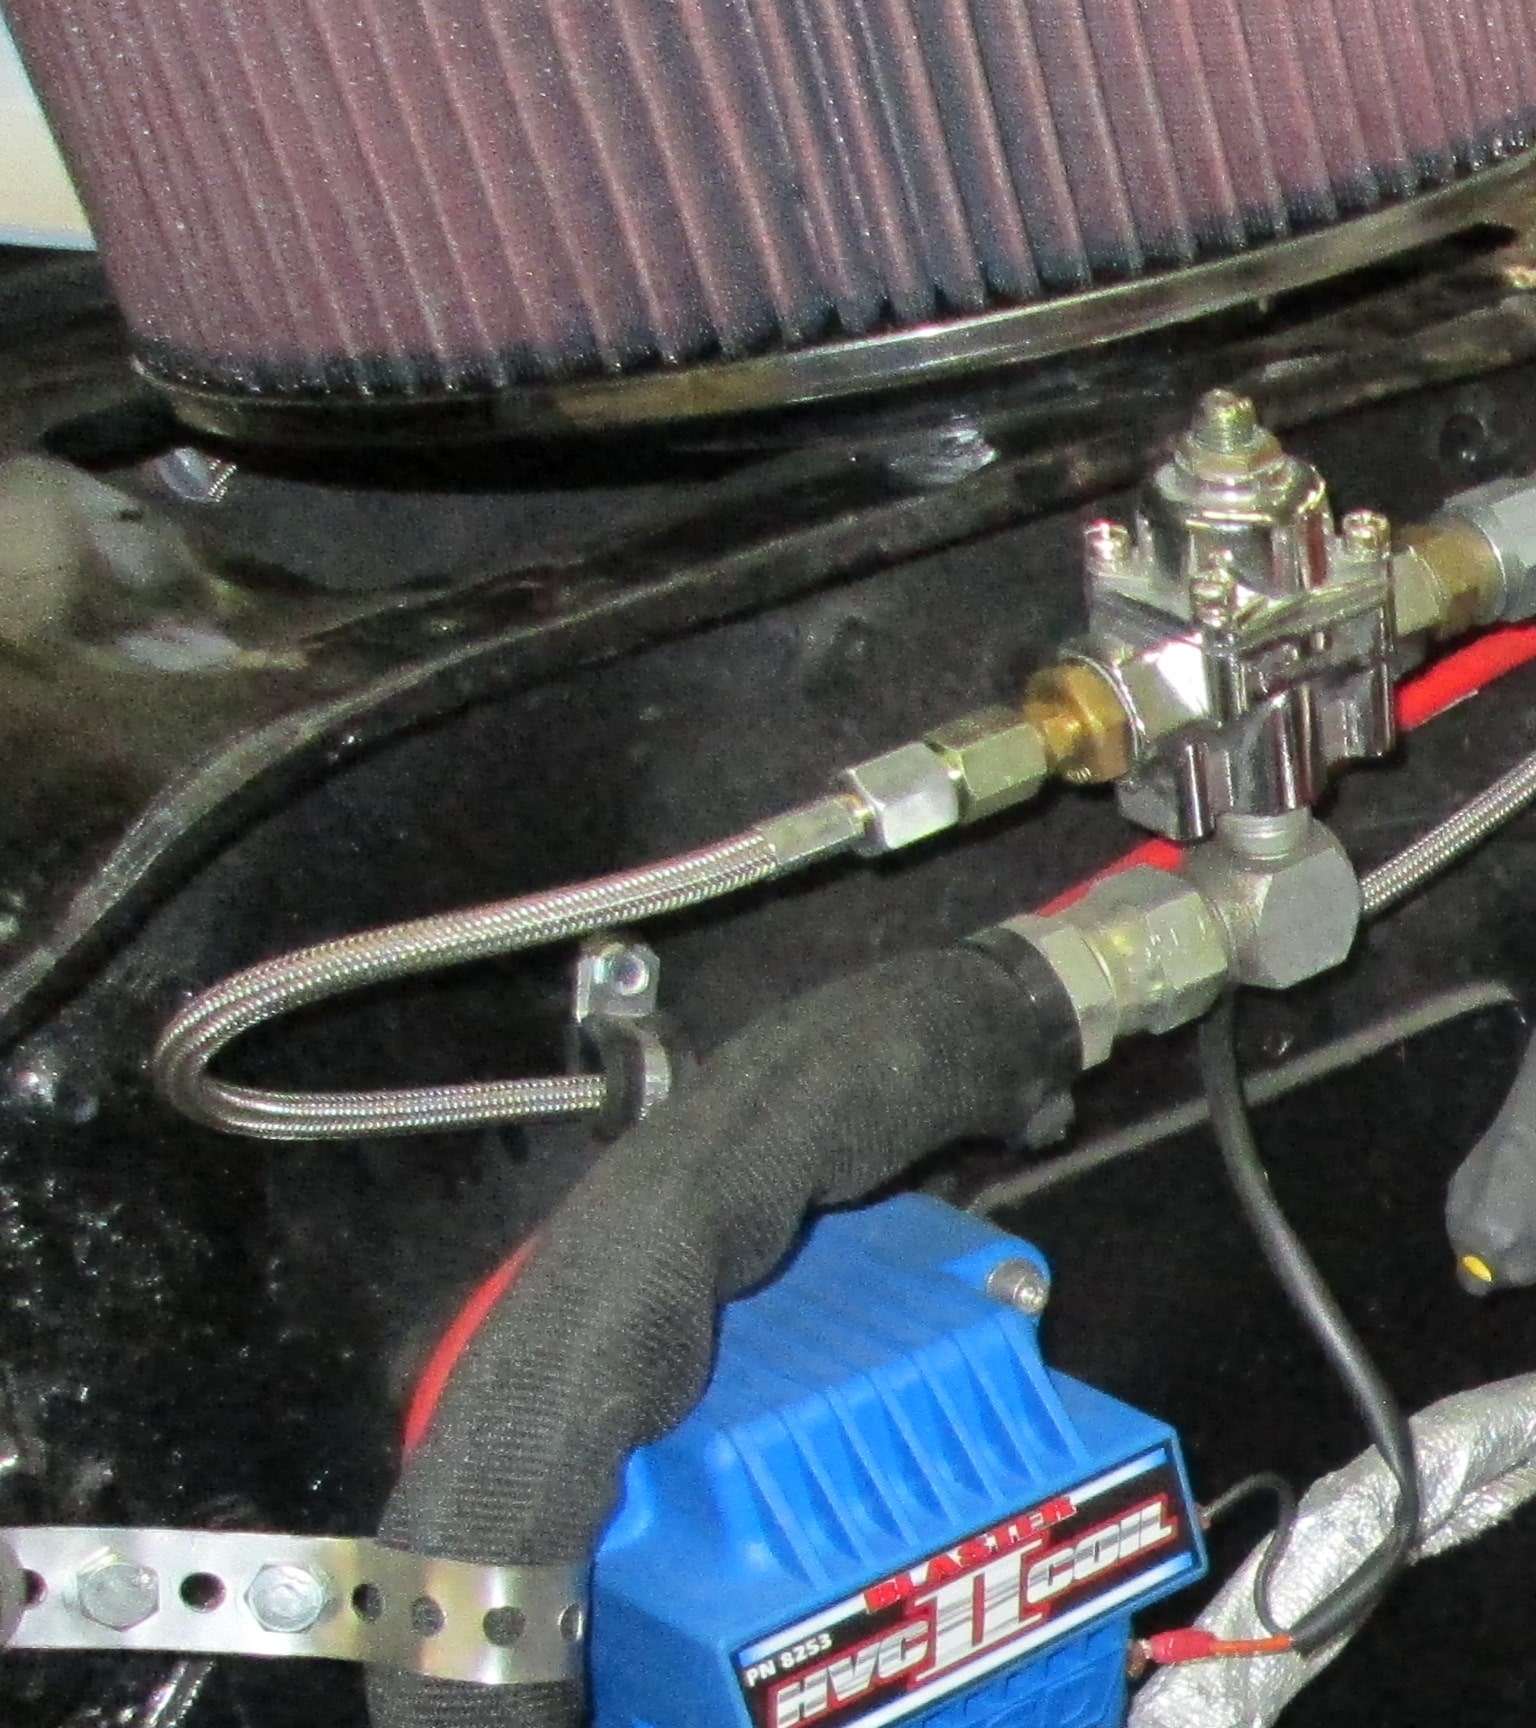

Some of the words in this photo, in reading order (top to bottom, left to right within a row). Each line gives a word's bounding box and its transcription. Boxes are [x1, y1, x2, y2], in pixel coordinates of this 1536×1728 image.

[862, 1494, 1077, 1616] BLASTER
[914, 1539, 1046, 1682] II
[1025, 1500, 1174, 1604] COIL
[744, 1659, 777, 1690] PN
[779, 1631, 836, 1671] 8253
